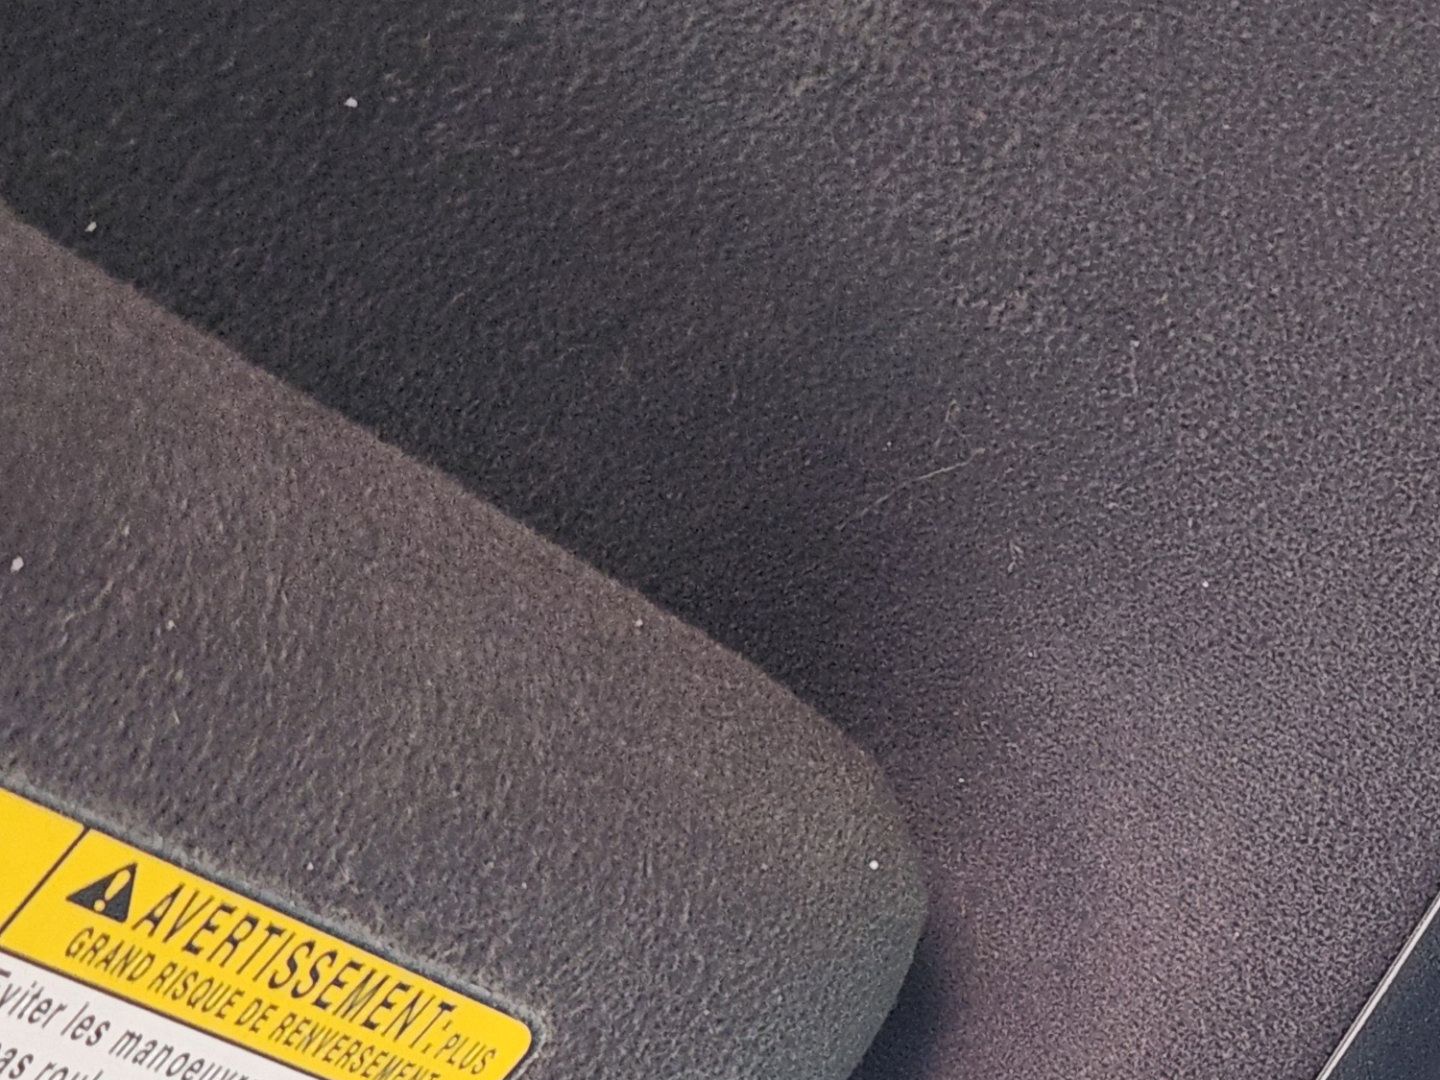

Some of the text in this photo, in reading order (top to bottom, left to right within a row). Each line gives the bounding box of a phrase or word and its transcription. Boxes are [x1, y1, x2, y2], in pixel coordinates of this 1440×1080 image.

[0, 968, 68, 1029] viter
[61, 1001, 111, 1047] les
[65, 926, 156, 982] GRAND
[147, 961, 246, 1020] RISQUE
[234, 998, 278, 1033] DE
[433, 1032, 497, 1076] PLUS
